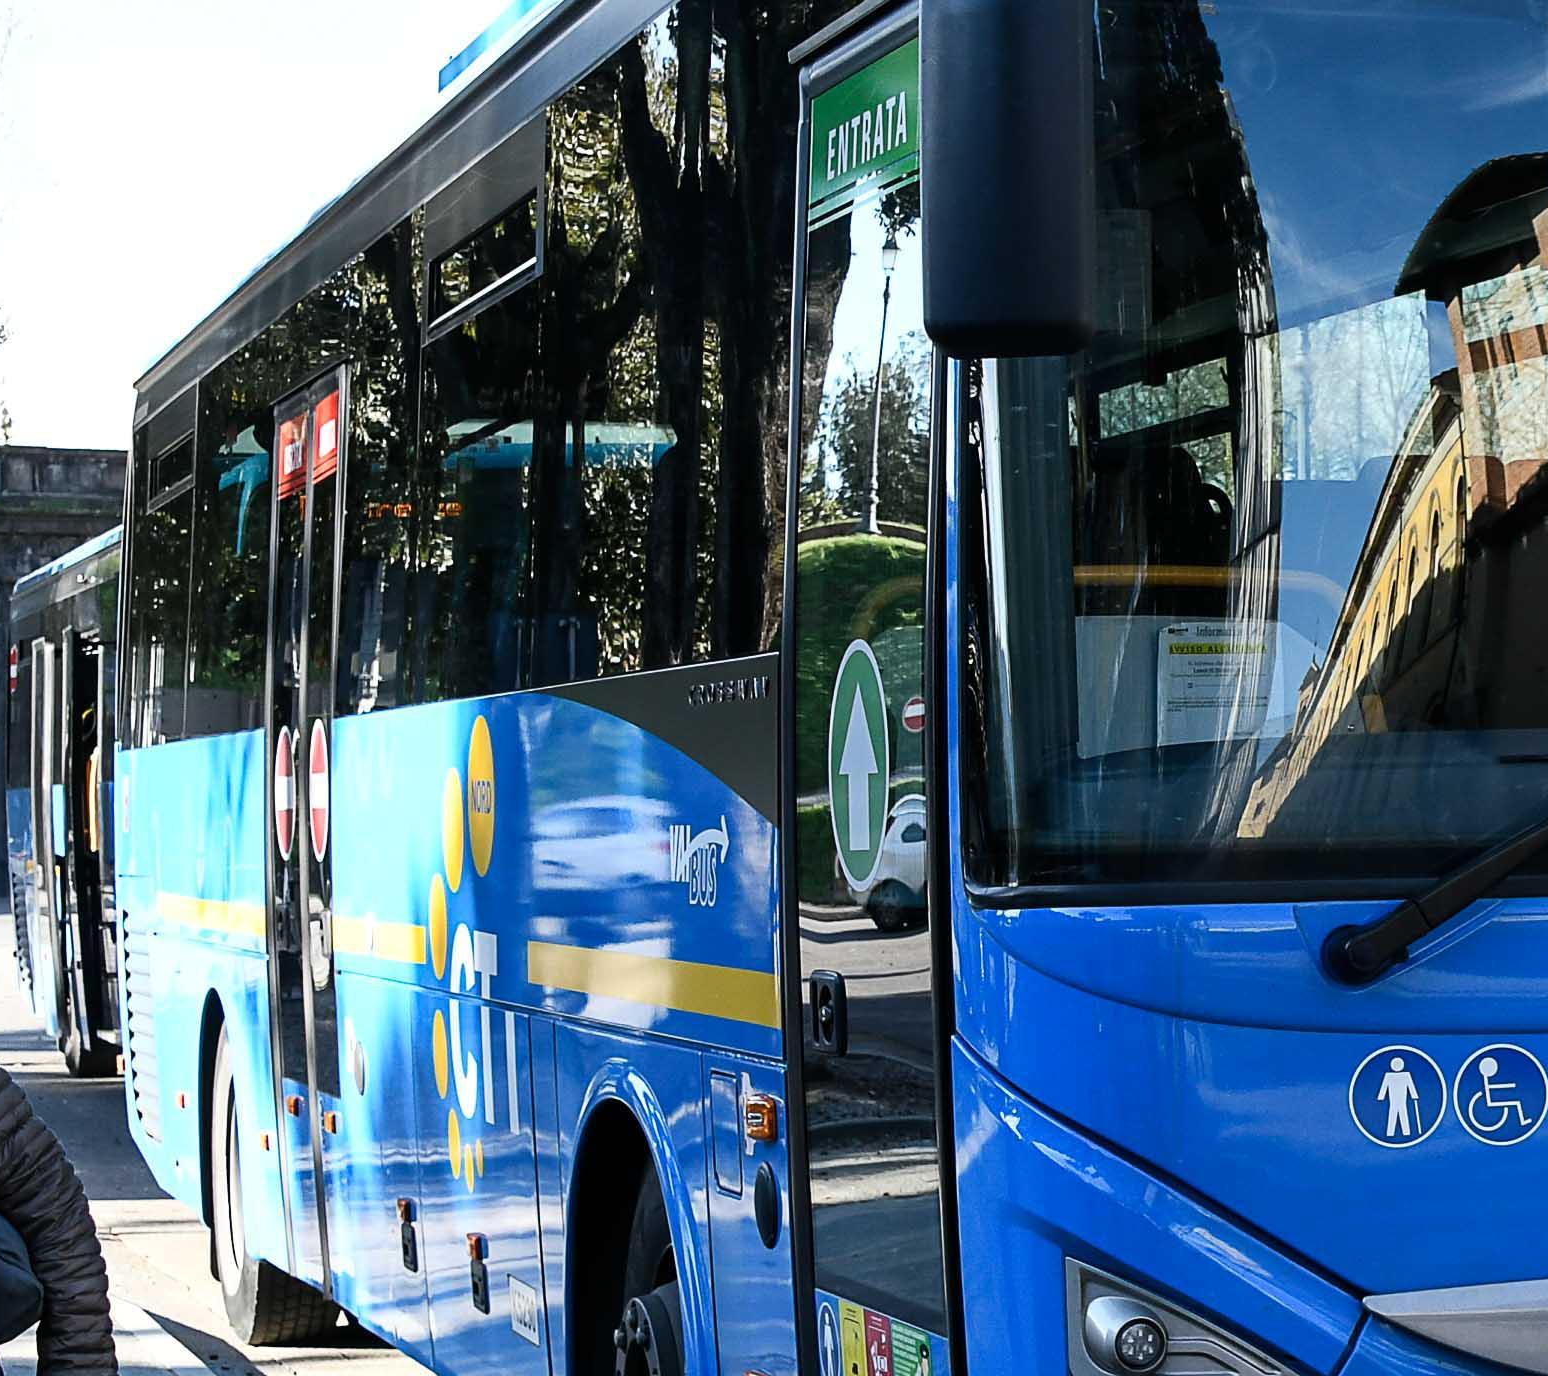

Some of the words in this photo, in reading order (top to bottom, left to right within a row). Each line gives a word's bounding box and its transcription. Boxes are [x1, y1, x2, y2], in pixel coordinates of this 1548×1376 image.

[826, 91, 907, 182] ENTRATA
[471, 780, 492, 814] NORD
[689, 843, 717, 907] BUS
